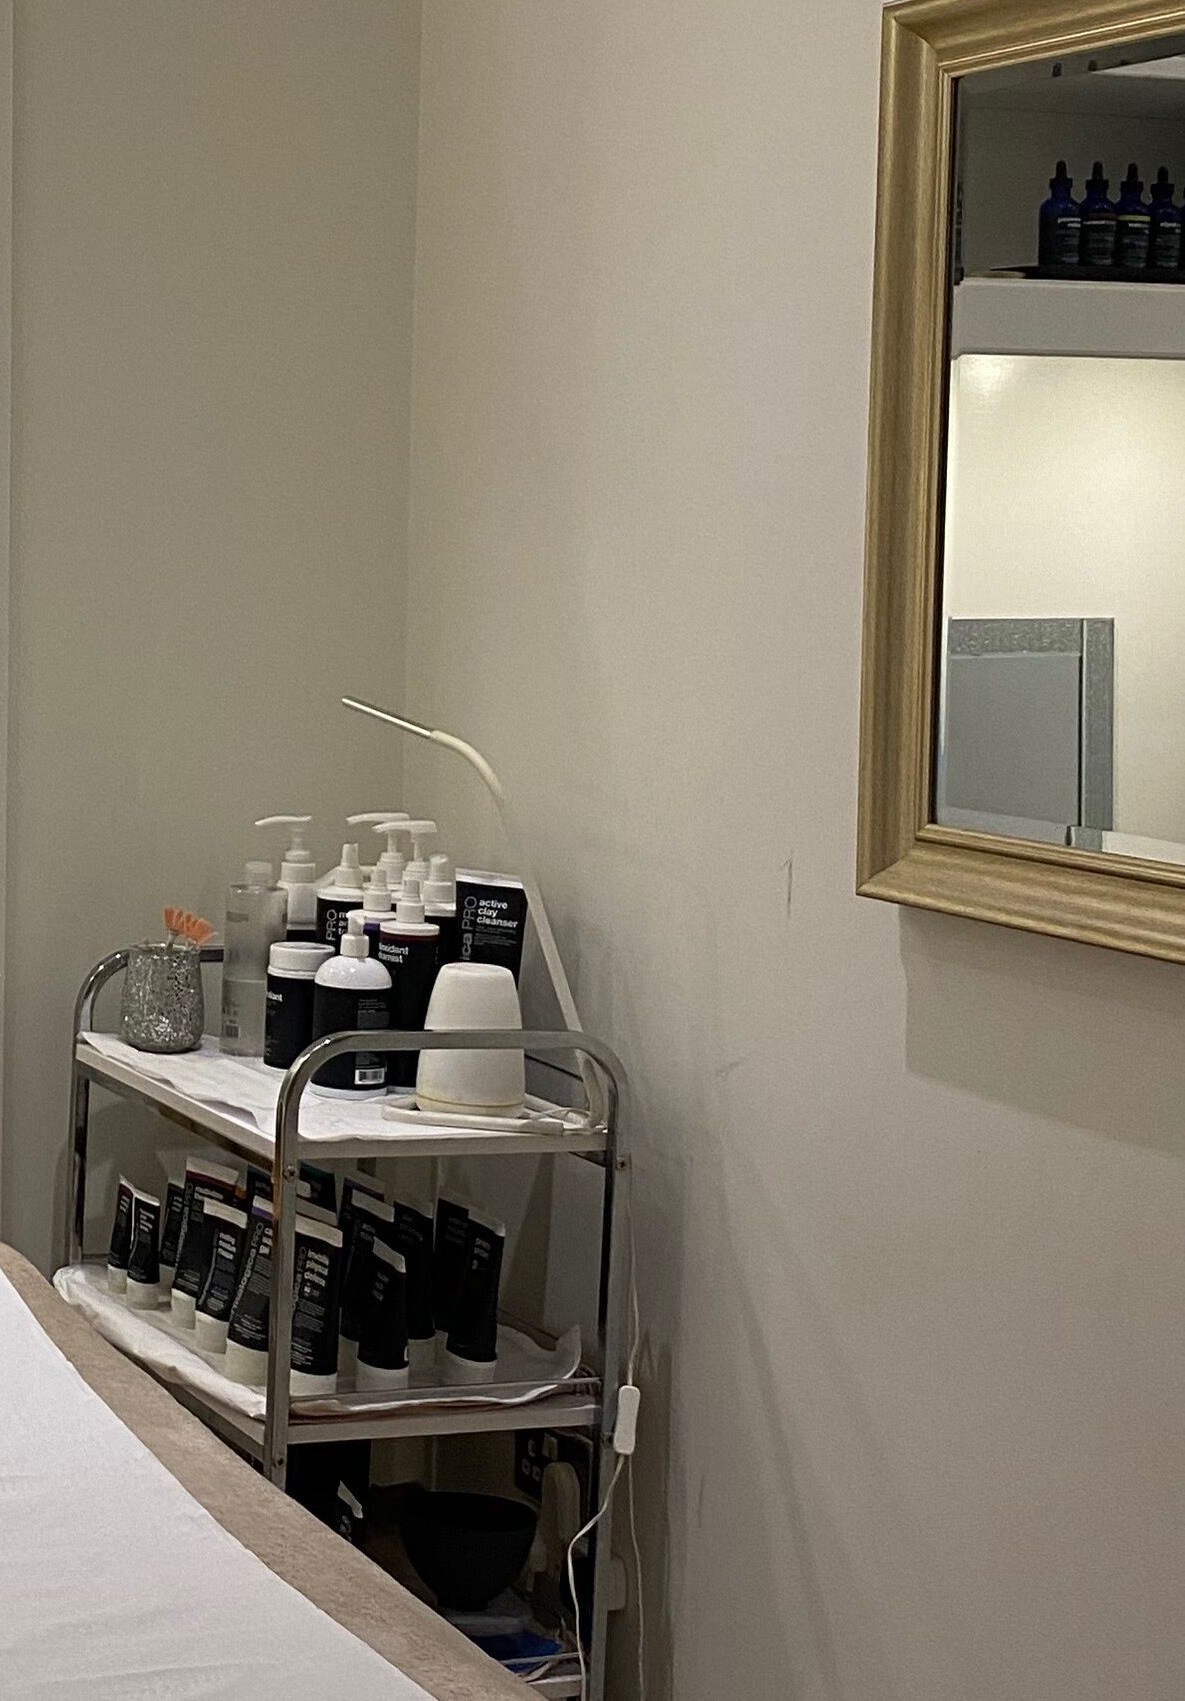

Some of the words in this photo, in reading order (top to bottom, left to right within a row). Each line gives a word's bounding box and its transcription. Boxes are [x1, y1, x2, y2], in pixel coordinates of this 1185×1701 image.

[479, 899, 508, 909] active
[477, 907, 498, 917] clay
[476, 916, 519, 928] cleanser
